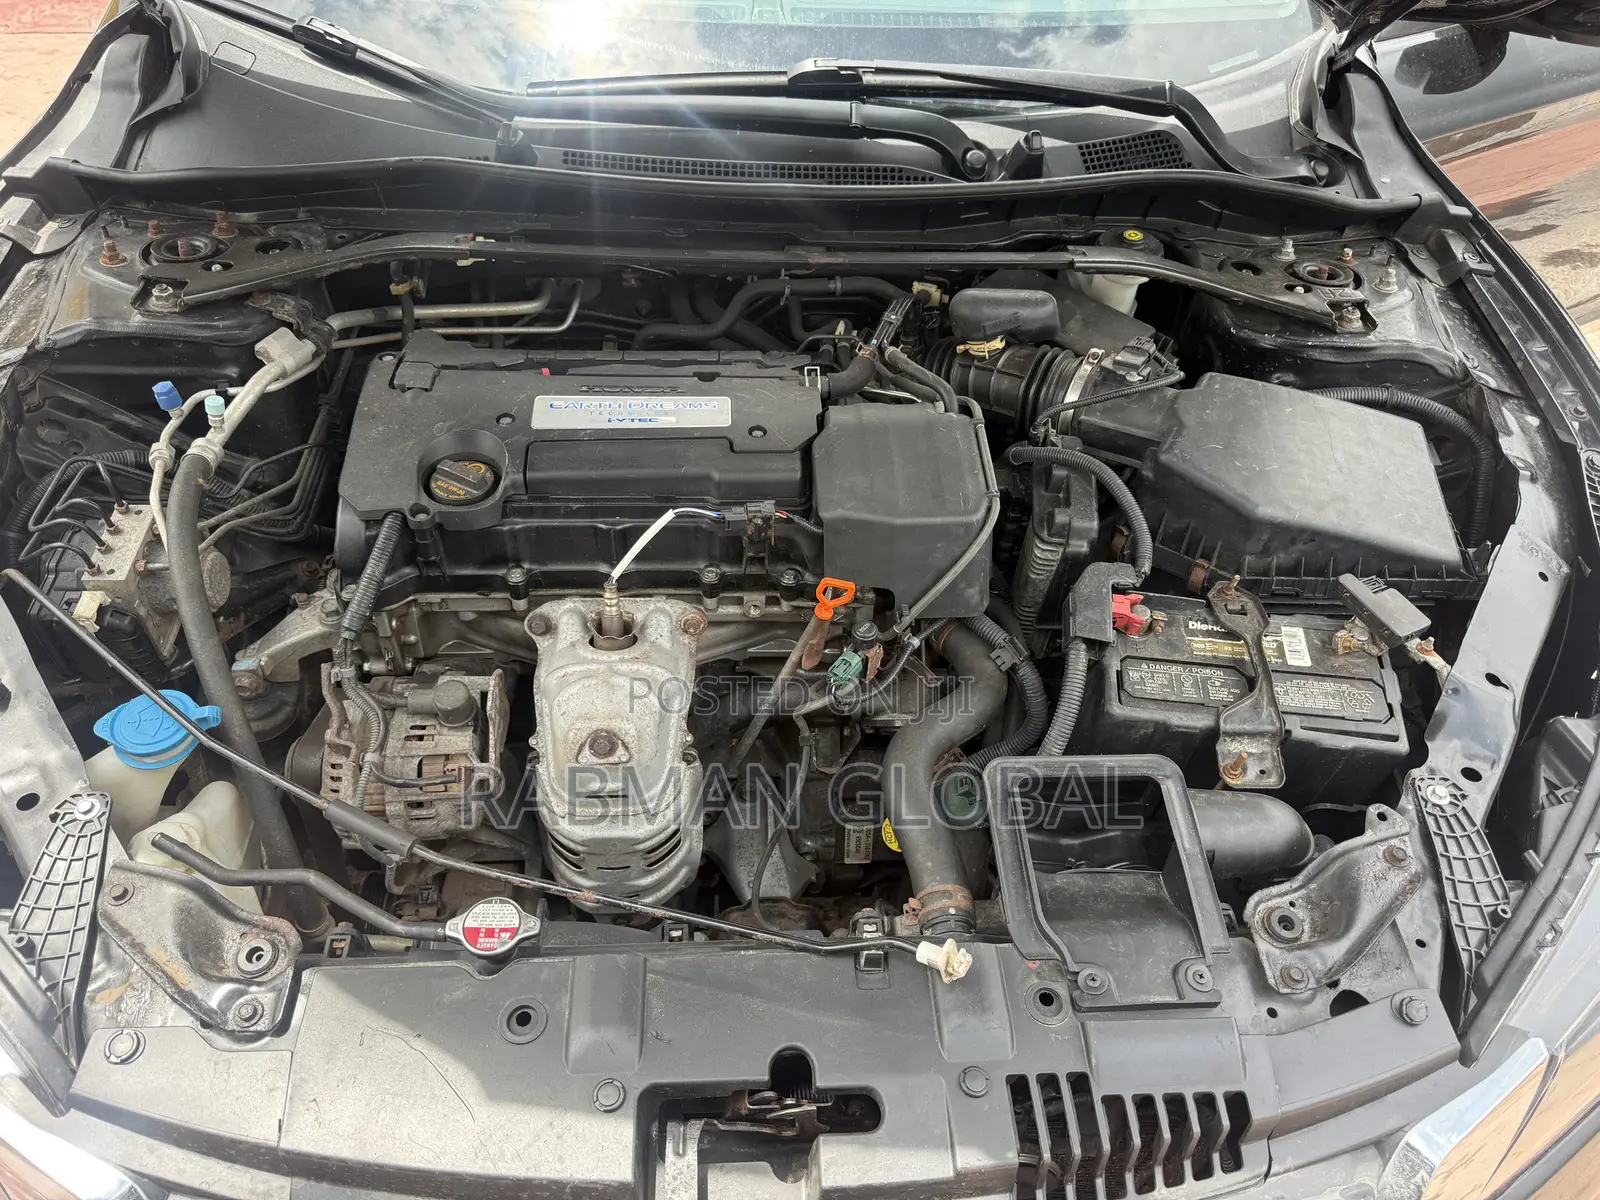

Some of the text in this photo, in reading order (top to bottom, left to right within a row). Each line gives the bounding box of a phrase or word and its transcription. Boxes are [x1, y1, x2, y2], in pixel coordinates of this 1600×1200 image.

[579, 384, 687, 394] HONDA
[549, 401, 718, 410] EARTH DREAMS
[1149, 663, 1184, 673] DANGER
[1191, 667, 1224, 677] POISON
